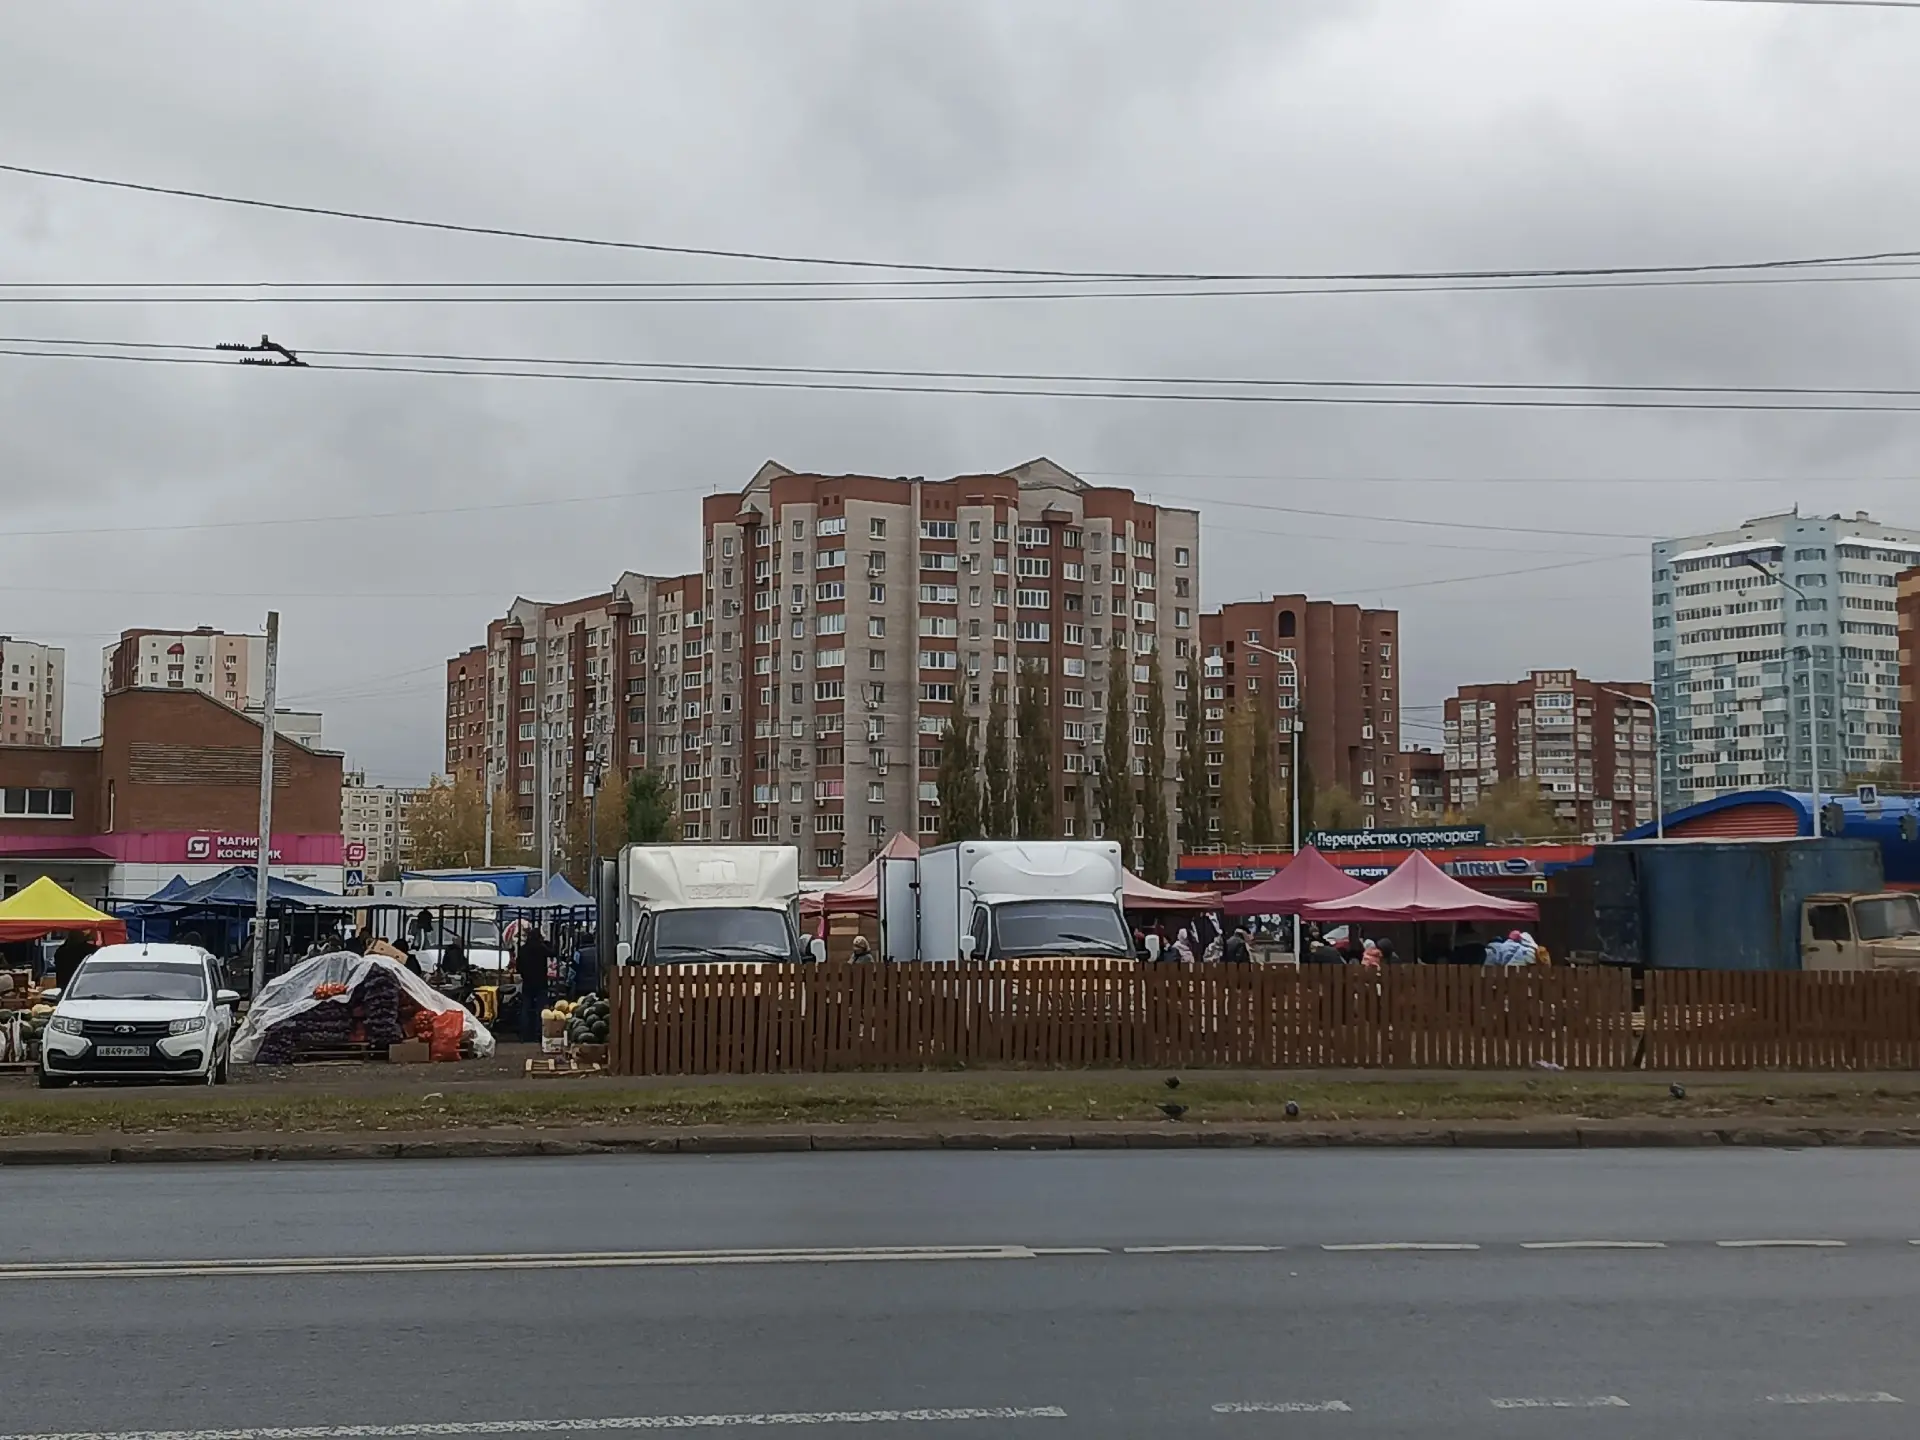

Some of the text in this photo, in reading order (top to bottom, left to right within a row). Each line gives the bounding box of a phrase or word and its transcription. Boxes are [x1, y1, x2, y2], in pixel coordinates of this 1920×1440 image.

[1317, 830, 1481, 850] Перекрёсток супермаркет
[217, 849, 282, 860] КОСМЕИК
